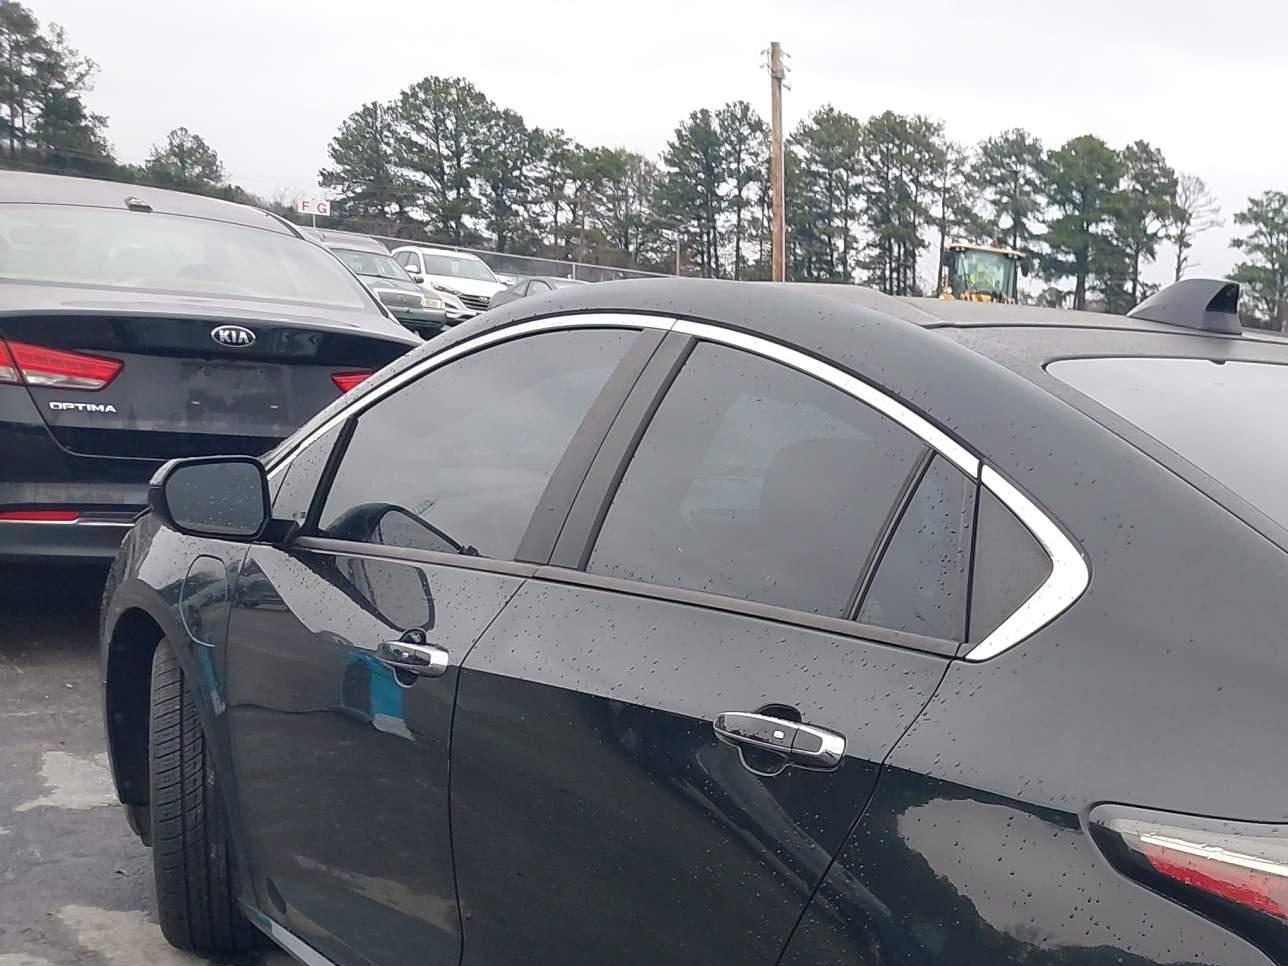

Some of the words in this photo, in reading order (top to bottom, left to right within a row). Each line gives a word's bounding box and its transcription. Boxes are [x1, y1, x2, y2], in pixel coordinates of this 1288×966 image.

[302, 200, 310, 211] F
[317, 202, 328, 214] G
[218, 329, 250, 344] KIA
[50, 401, 117, 413] OPTIMA
